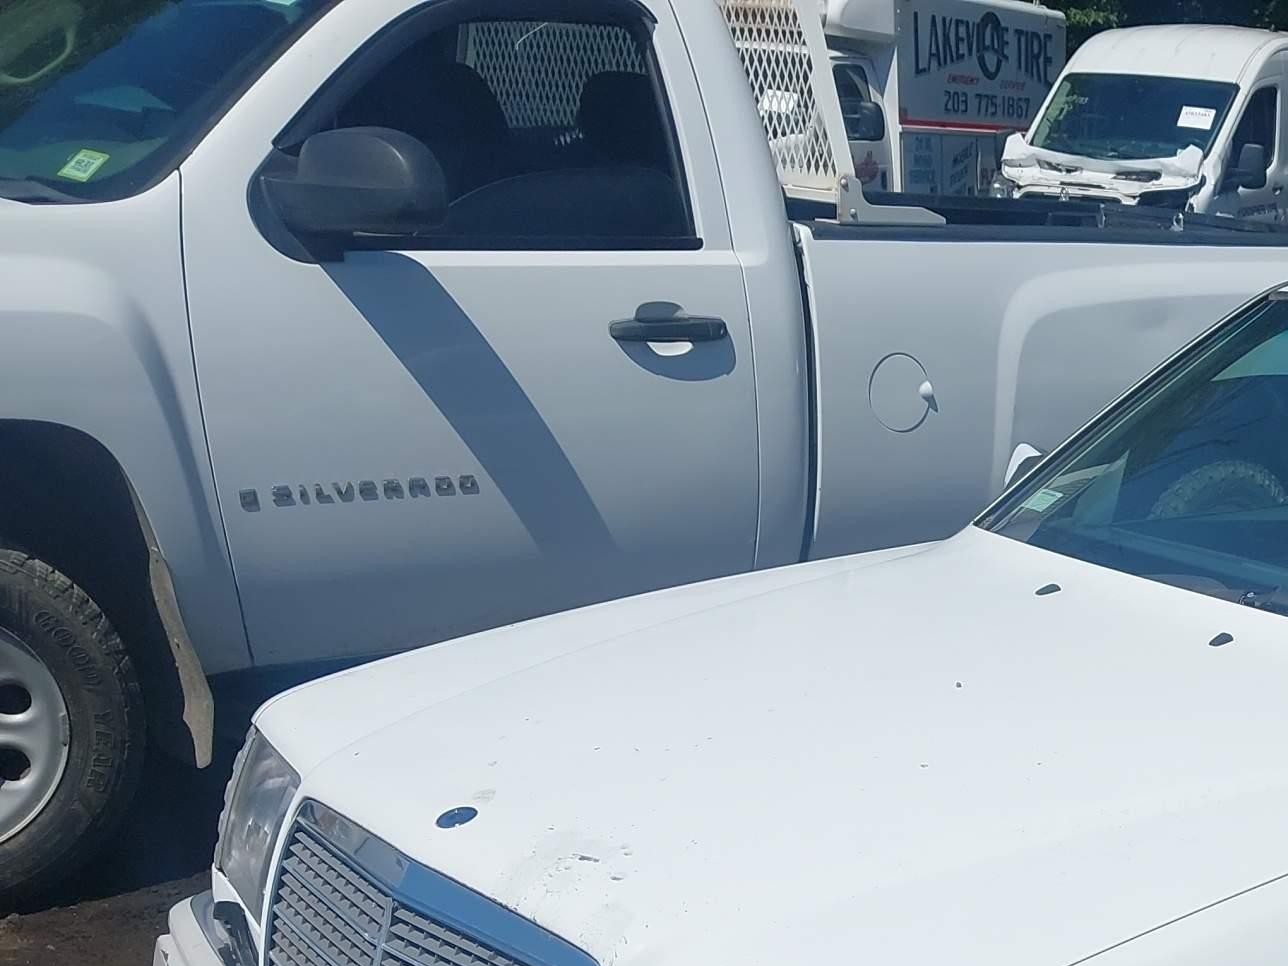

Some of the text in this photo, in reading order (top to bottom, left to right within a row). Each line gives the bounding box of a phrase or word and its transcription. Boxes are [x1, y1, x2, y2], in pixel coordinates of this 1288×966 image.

[1014, 28, 1054, 88] TIRE
[944, 90, 969, 113] 203
[272, 474, 480, 507] SILVERADO
